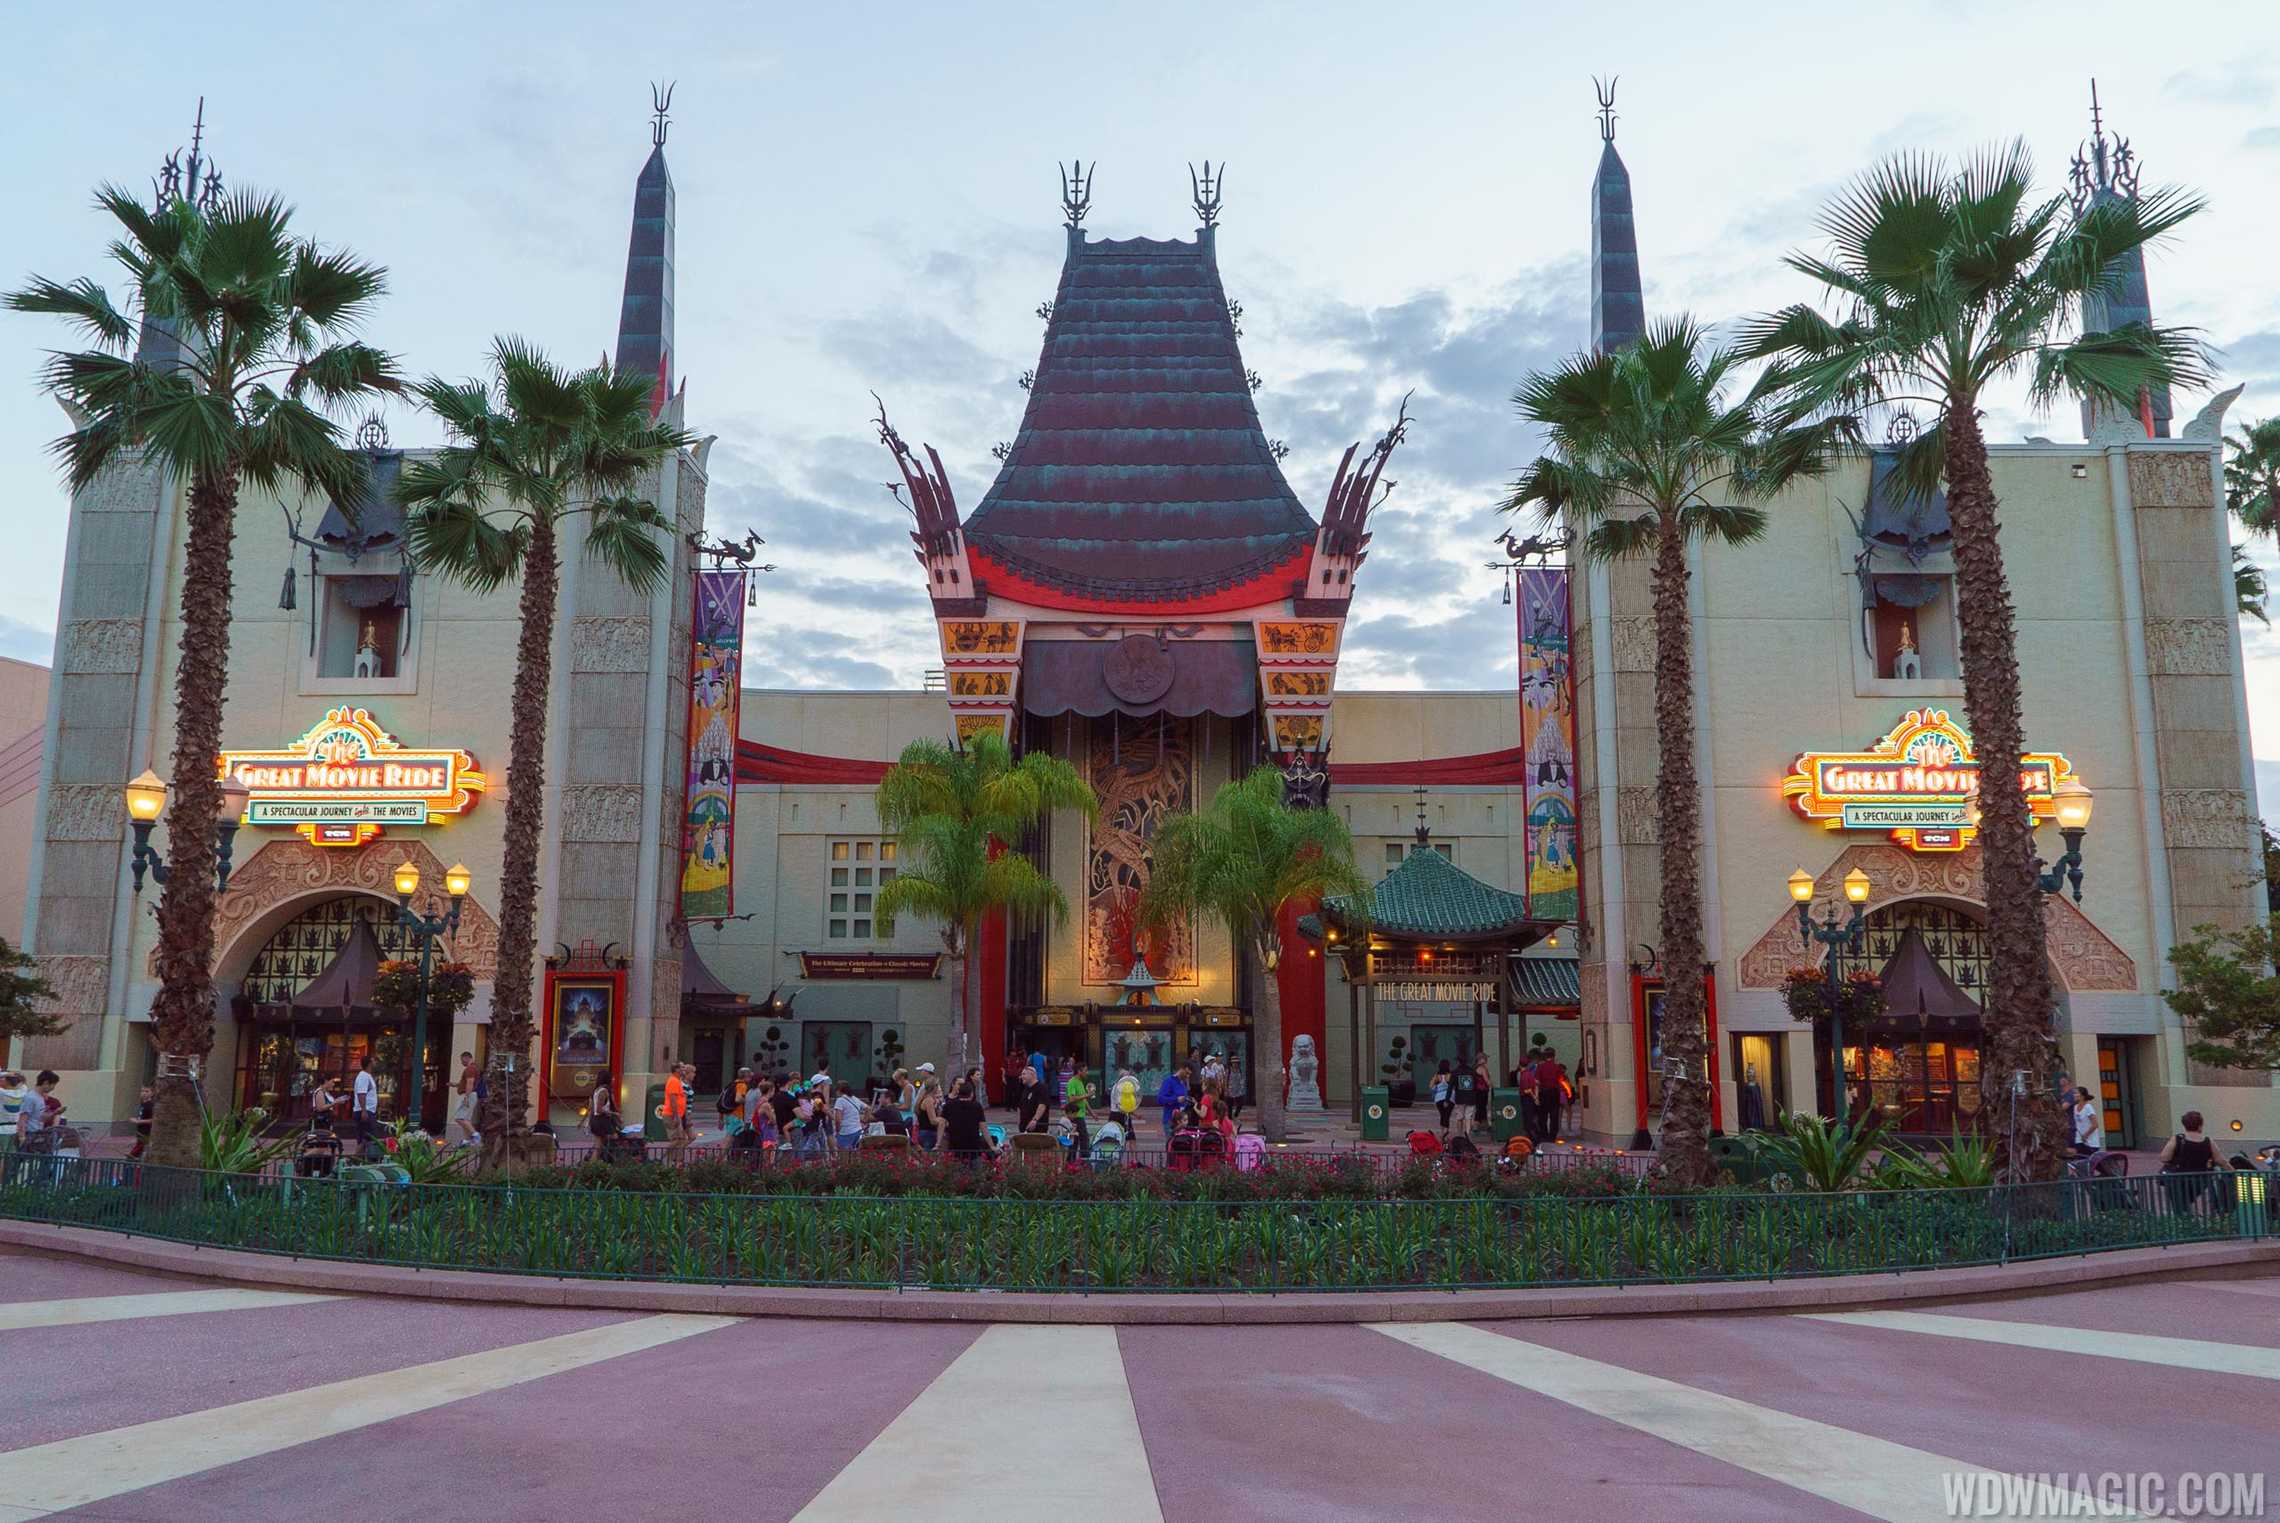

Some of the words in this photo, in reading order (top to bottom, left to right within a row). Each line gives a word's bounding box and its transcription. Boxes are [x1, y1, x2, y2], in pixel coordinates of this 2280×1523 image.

[305, 763, 383, 788] MOVIE
[384, 763, 446, 788] RIDE
[1823, 766, 1900, 792] GREAT
[262, 806, 268, 817] A
[270, 806, 318, 817] SPECTACULAR
[320, 806, 352, 817] JOURNEY
[373, 806, 387, 817] THE
[389, 806, 417, 817] MOVIES
[1854, 811, 1861, 821] A
[1863, 811, 1913, 821] SPECTACULAR
[1915, 811, 1949, 821] JOURNEY
[1378, 982, 1396, 1001] THE
[1400, 982, 1432, 1001] GREAT
[1435, 982, 1467, 1001] MOVIE
[1472, 982, 1497, 1002] RIDE
